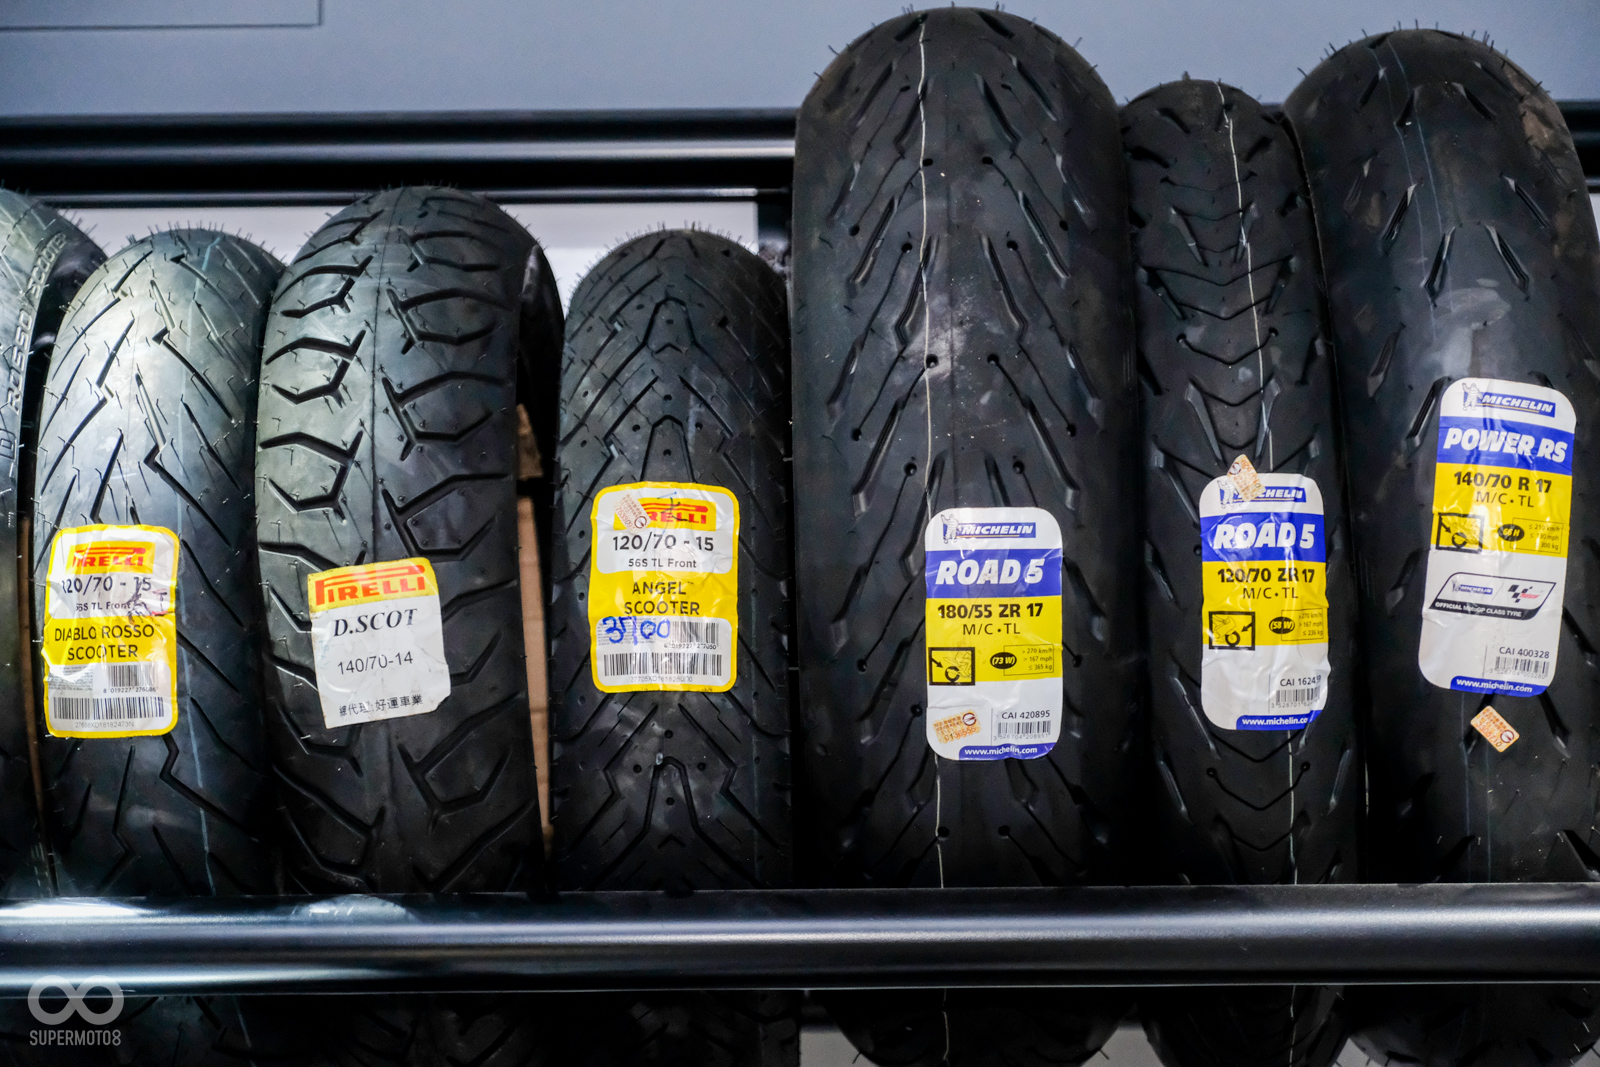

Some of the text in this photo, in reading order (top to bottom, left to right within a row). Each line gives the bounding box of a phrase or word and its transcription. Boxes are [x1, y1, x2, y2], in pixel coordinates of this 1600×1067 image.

[1482, 393, 1554, 413] MICHELIN
[1443, 427, 1568, 463] POWER RS
[1454, 471, 1552, 494] 140/70 R 17
[960, 523, 1034, 535] MICHELIN
[1213, 523, 1316, 549] ROAD 5
[1513, 529, 1520, 537] H
[613, 532, 677, 552] 120/70
[696, 536, 714, 552] 15
[72, 547, 147, 567] PIRELLI
[628, 558, 697, 568] 56S TL Front
[934, 558, 1046, 585] ROAD 5
[1217, 567, 1315, 583] 120/70 ZR 17
[315, 564, 426, 606] PIRELLI
[632, 581, 687, 596] ANGEL
[624, 601, 700, 616] SCOOTER
[937, 602, 1044, 620] 180/55 ZR 17
[1435, 602, 1462, 611] OFFICIAL
[1486, 607, 1505, 616] CLASS
[1506, 609, 1522, 617] TYRE
[333, 608, 418, 637] D.SCOT
[55, 624, 156, 642] DIABLO ROSSO
[67, 644, 139, 660] SCOOTER
[1499, 646, 1550, 659] CAI 400328
[337, 651, 414, 675] 140/70-14
[1280, 678, 1295, 687] CAI
[1456, 678, 1533, 692] www.michelin.com
[1001, 709, 1051, 720] CAI 420895
[964, 746, 1038, 756] www.michelin.com
